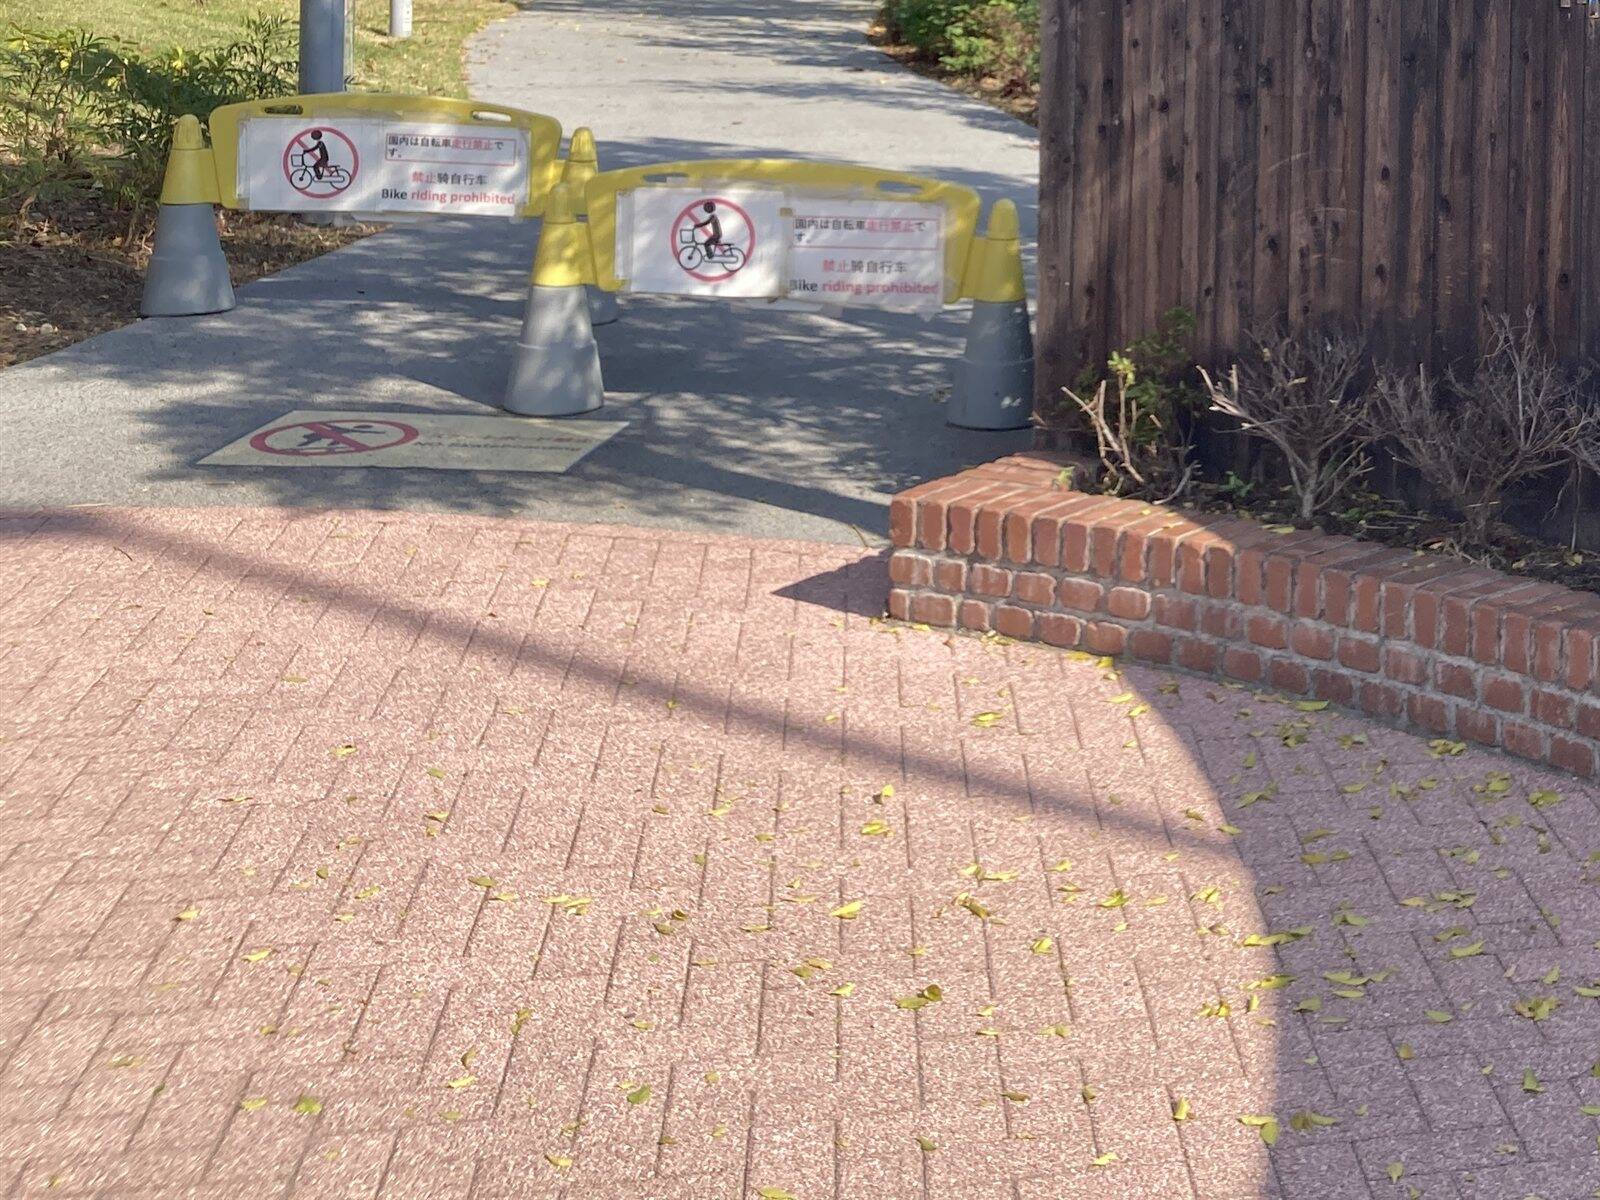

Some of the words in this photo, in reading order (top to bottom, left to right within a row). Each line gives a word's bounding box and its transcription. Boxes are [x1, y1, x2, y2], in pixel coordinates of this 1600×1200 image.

[381, 188, 408, 200] Bike
[410, 189, 447, 203] riding
[450, 191, 515, 205] prohibited
[821, 280, 864, 295] riding
